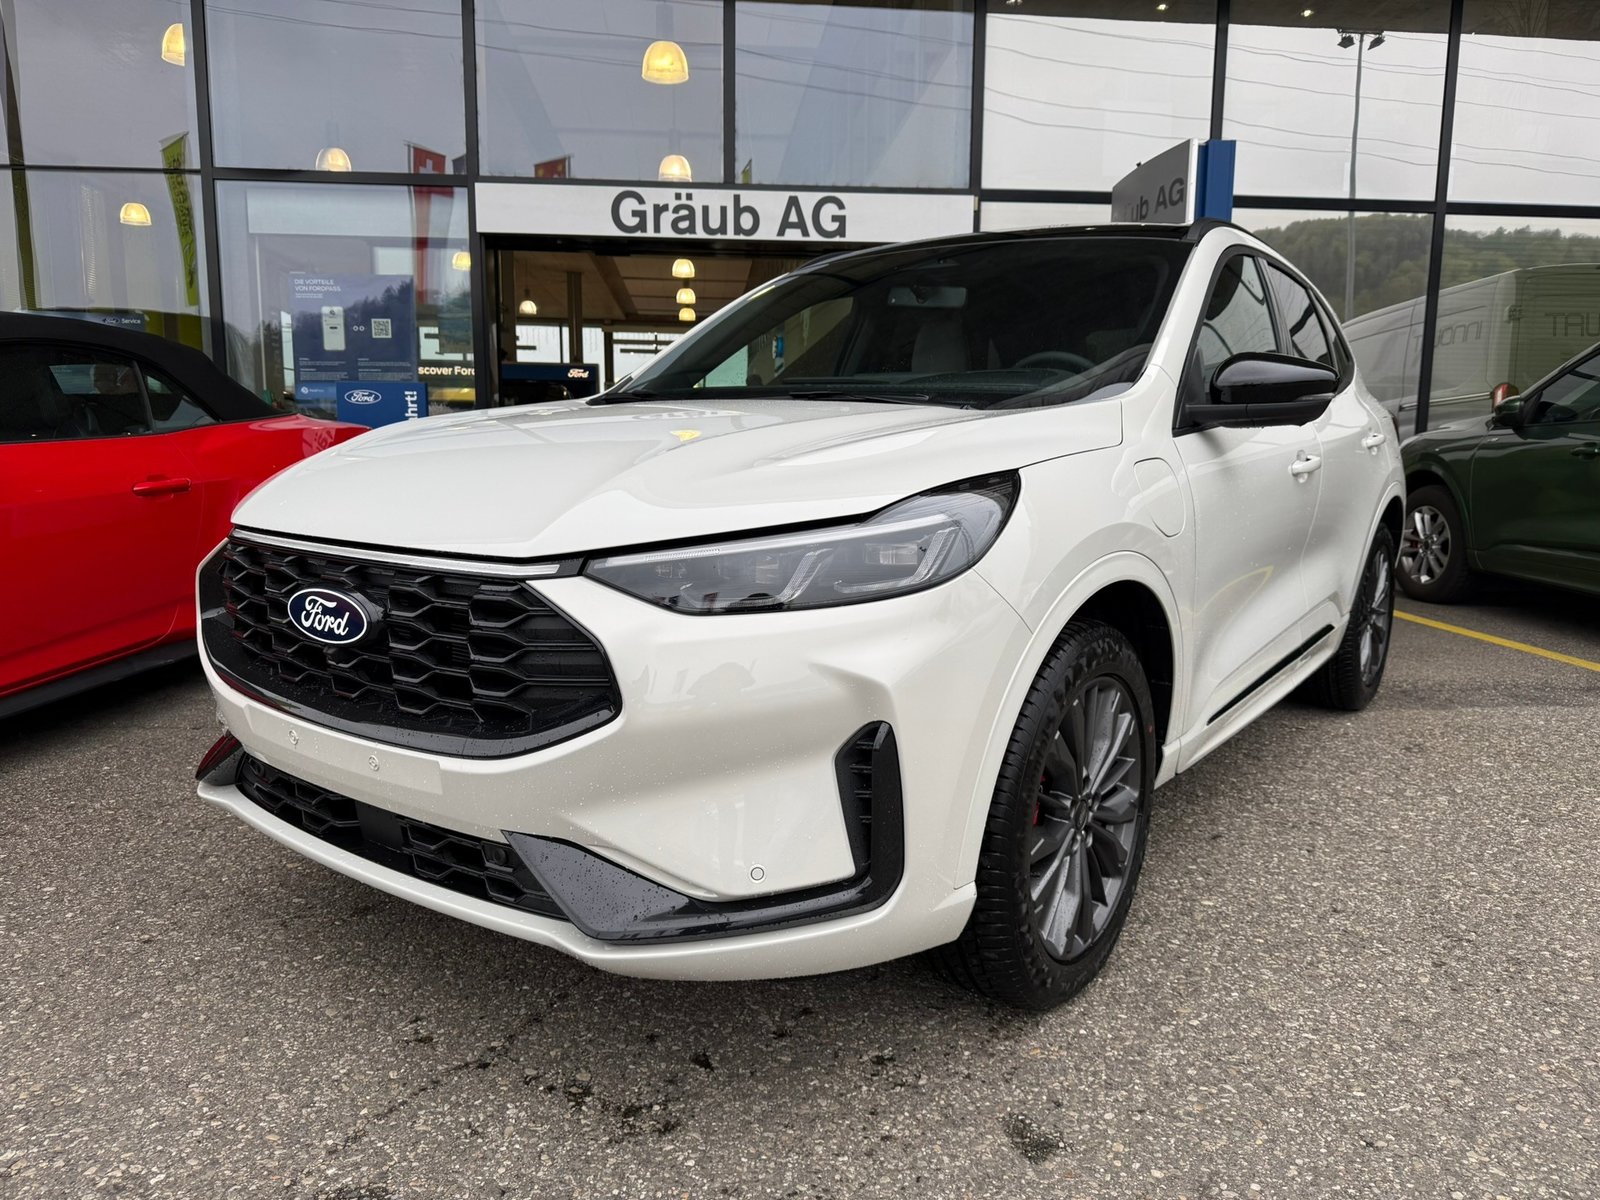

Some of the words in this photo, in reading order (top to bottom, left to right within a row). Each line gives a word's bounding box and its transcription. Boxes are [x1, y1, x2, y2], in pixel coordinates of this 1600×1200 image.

[611, 190, 760, 235] Gräub
[776, 196, 847, 238] AG
[1154, 177, 1185, 214] AG
[418, 366, 452, 375] scover
[568, 368, 589, 378] Ford
[301, 596, 350, 635] Ford
